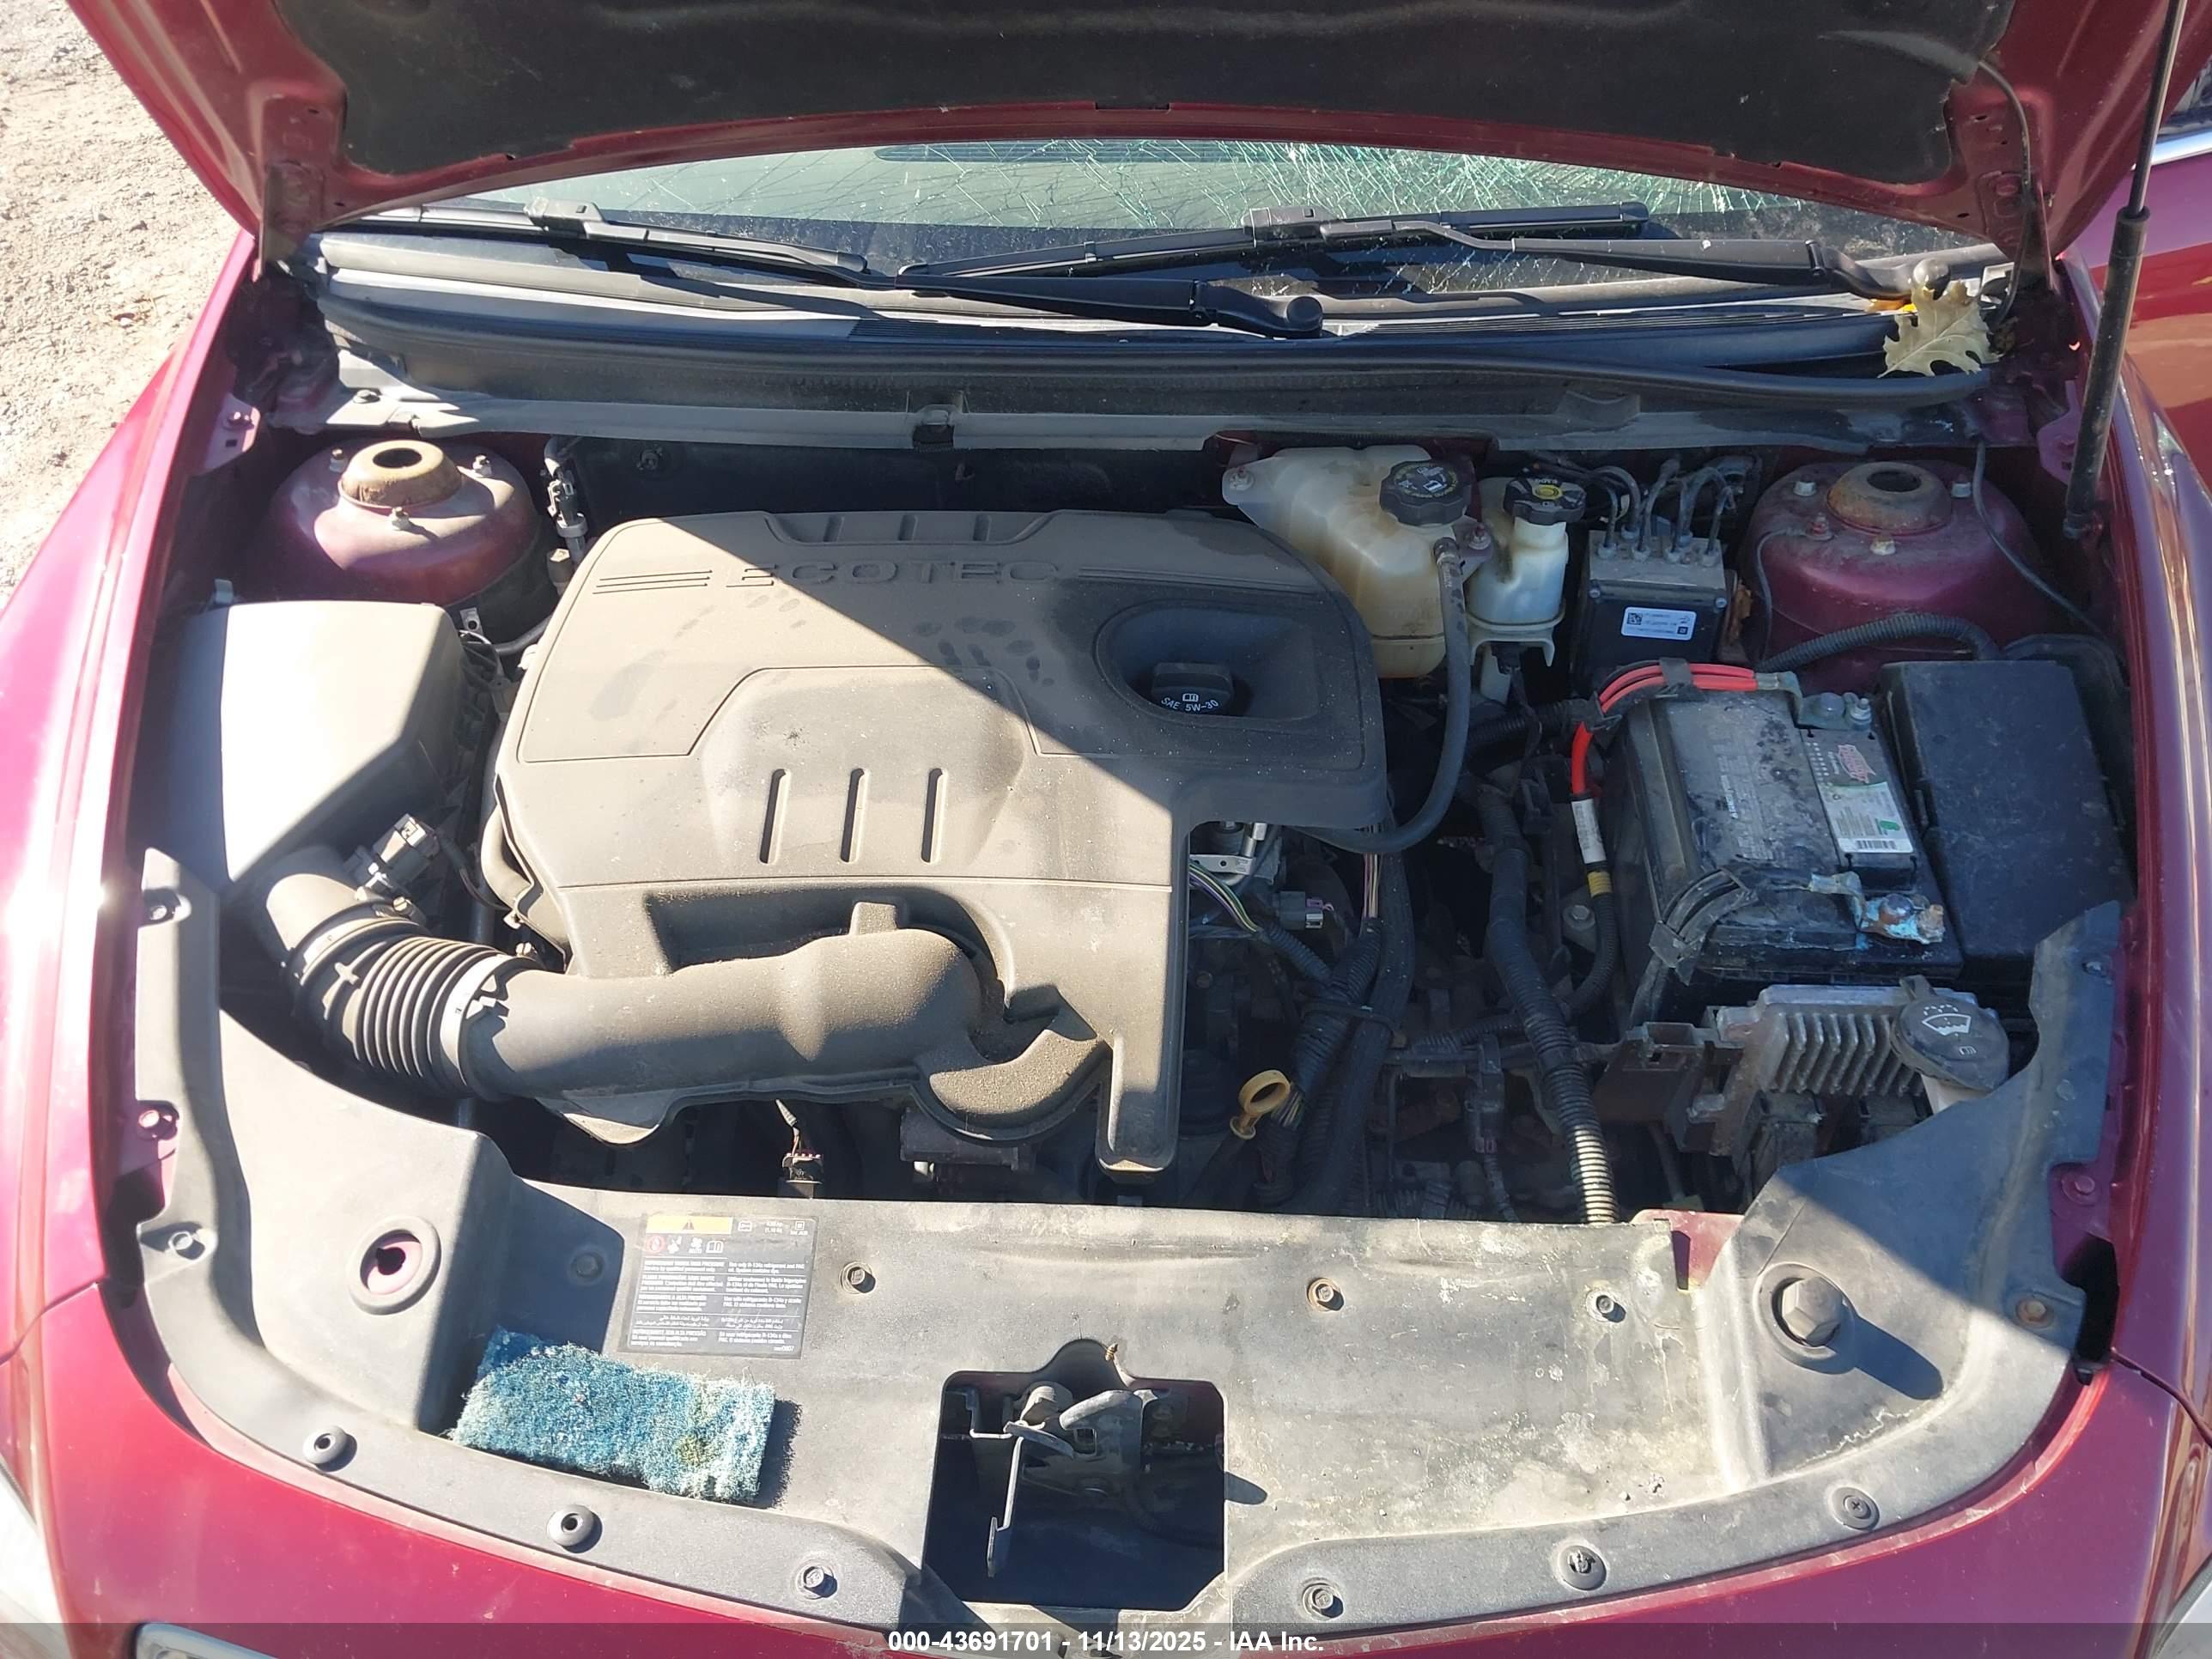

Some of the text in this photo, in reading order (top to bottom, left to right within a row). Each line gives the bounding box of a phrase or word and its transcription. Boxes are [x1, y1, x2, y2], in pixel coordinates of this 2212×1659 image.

[726, 559, 1059, 587] ECOTEC
[1161, 697, 1218, 712] SAE 5W-30
